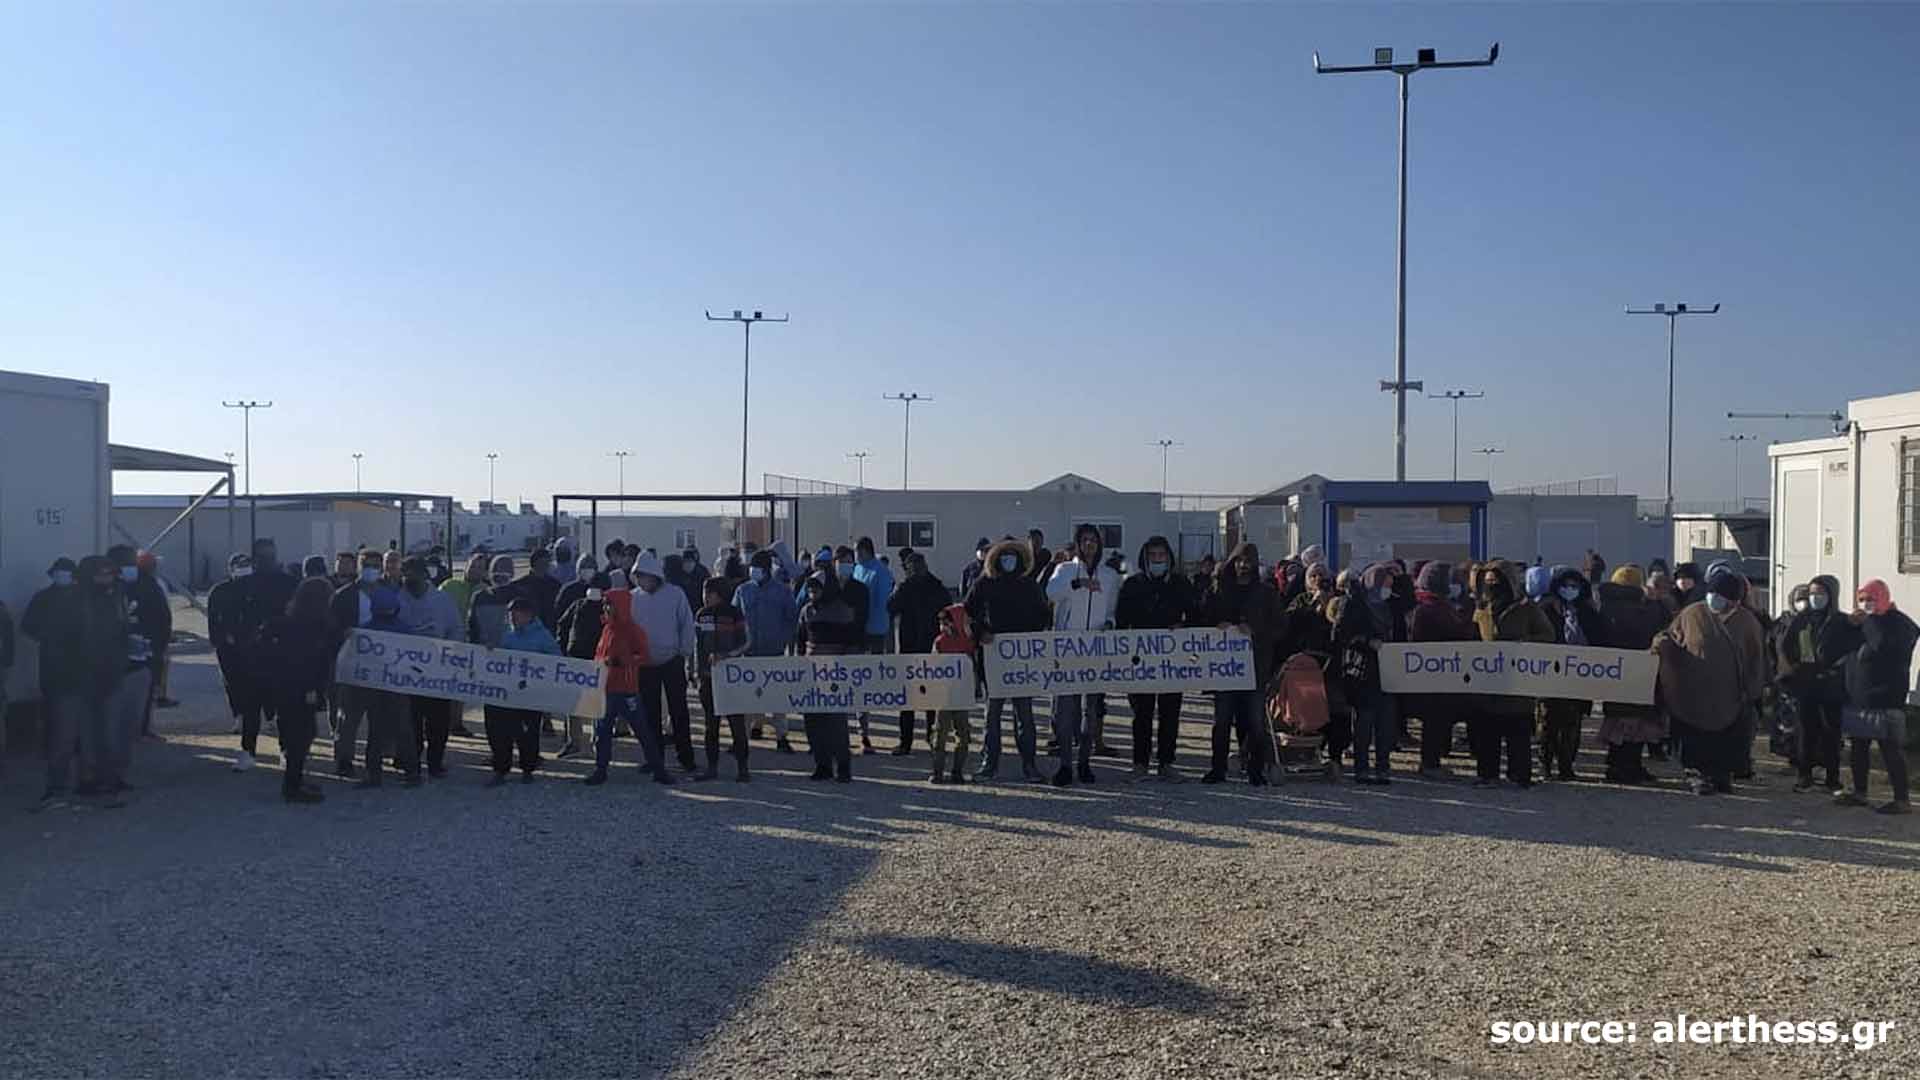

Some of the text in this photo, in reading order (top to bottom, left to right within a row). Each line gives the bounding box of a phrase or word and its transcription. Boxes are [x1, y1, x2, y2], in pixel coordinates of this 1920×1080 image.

[356, 634, 385, 656] Do
[394, 648, 432, 665] you
[555, 662, 600, 688] Food
[999, 639, 1047, 661] OUR
[1053, 635, 1130, 658] FAMILIS
[1135, 634, 1177, 656] AND
[353, 662, 370, 680] is
[726, 660, 962, 689] Do your kids go to school
[1002, 663, 1038, 686] ask
[1042, 666, 1075, 690] you
[1078, 667, 1097, 681] to
[1100, 659, 1157, 681] decide
[1472, 651, 1505, 674] cut
[1516, 657, 1550, 676] our
[1564, 655, 1623, 681] Food
[788, 685, 855, 707] without
